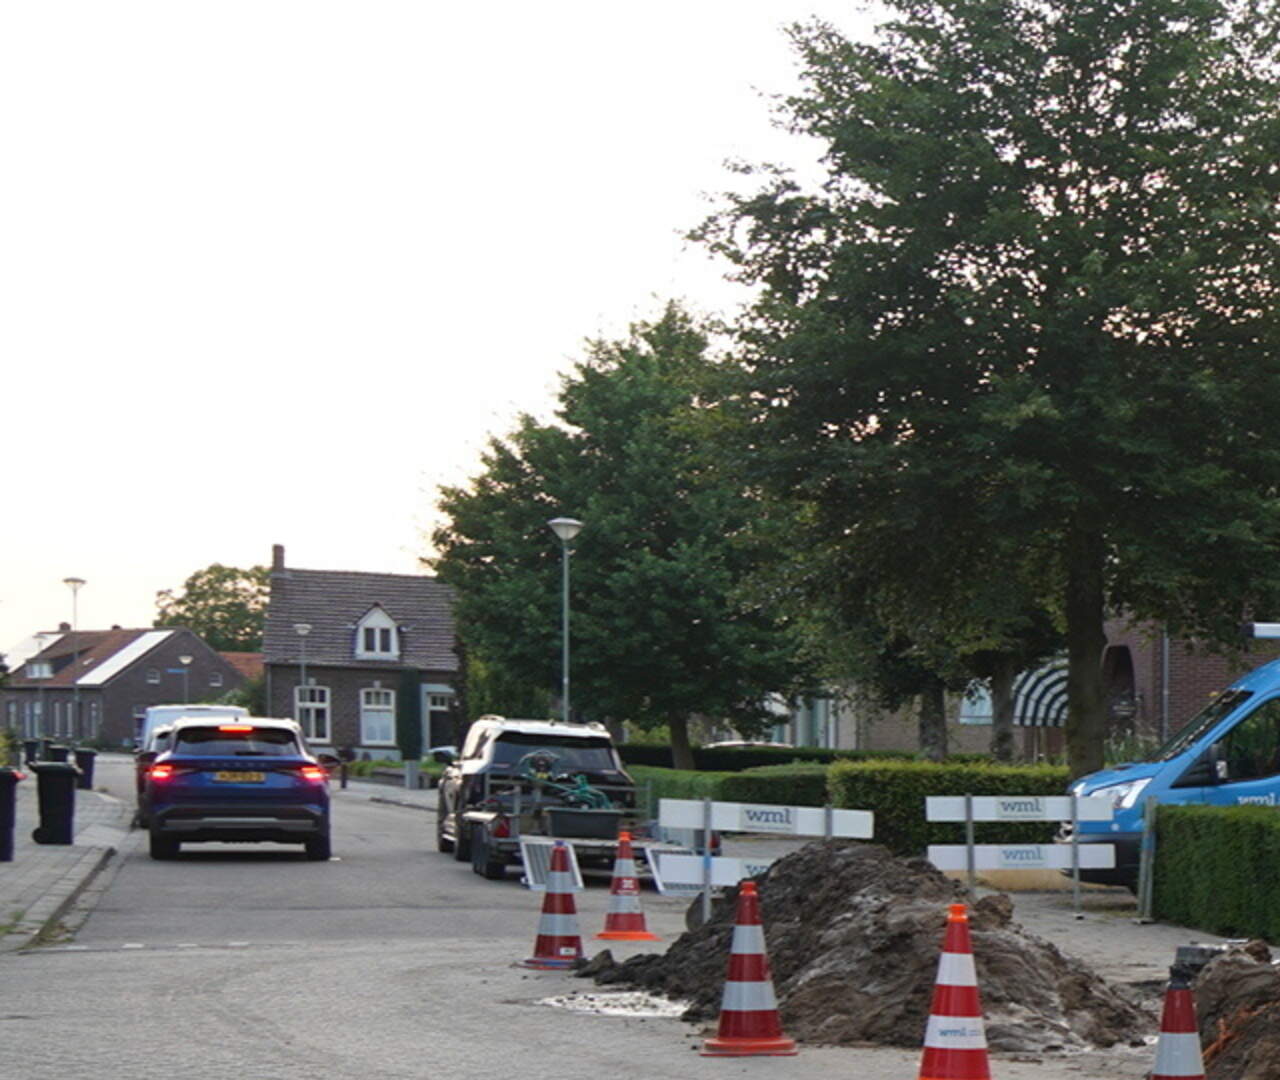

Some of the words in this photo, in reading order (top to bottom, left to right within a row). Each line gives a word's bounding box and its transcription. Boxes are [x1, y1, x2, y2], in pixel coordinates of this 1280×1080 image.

[1000, 798, 1043, 812] wml
[744, 808, 792, 824] wml
[1002, 846, 1045, 861] wml
